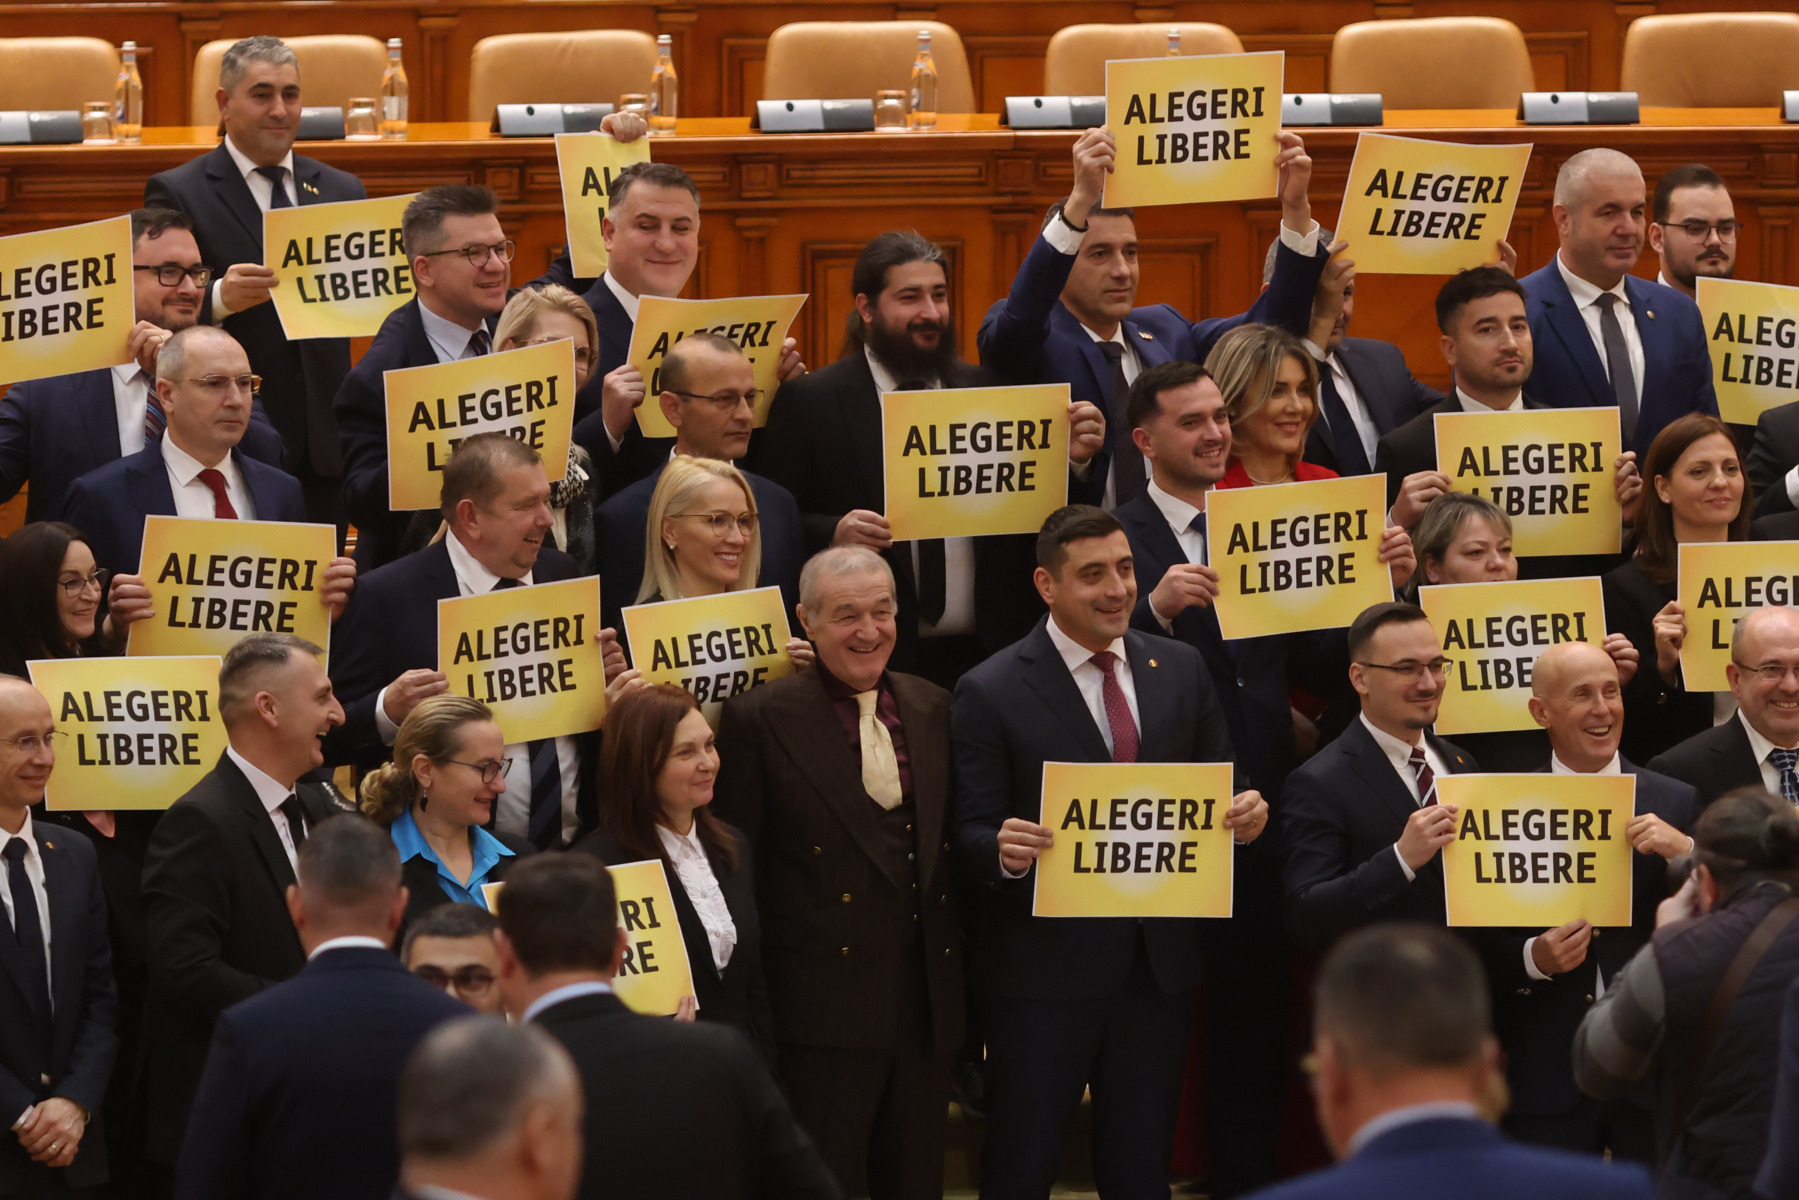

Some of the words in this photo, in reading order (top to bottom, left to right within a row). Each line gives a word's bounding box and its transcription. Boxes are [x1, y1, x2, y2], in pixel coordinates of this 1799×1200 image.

[1123, 86, 1265, 126] ALEGERI
[1136, 128, 1251, 166] LIBERE
[1364, 168, 1509, 204] ALEGERI
[1368, 207, 1487, 241] LIBERE
[281, 227, 407, 269] ALEGER
[0, 252, 117, 301] LEGERI
[296, 264, 412, 304] LIBERE
[1, 296, 105, 342] IBERE
[1712, 312, 1799, 349] ALEG
[1722, 352, 1799, 390] LIBE
[408, 374, 558, 433] ALEGERI
[902, 418, 1053, 457] ALEGERI
[1456, 441, 1604, 478] ALEGERI
[918, 460, 1037, 499] LIBERE
[1472, 483, 1591, 516] IBERE
[1226, 509, 1369, 556] ALEGERI
[157, 552, 318, 592] ALEGERI
[1239, 552, 1356, 595] LIBERE
[1697, 575, 1799, 609] ALEG
[167, 595, 298, 633] LIBERE
[1442, 611, 1588, 651] ALEGERI
[453, 613, 585, 665] ALEGERI
[651, 623, 778, 672] ALEGERI
[467, 658, 577, 705] LIBERE
[1458, 656, 1539, 692] LIBE
[60, 689, 211, 723] ALEGERI
[77, 733, 201, 766] LIBERE
[1061, 798, 1216, 831] ALEGERI
[1458, 808, 1613, 841] ALEGERI
[1073, 841, 1198, 874] LIBERE
[1473, 851, 1597, 884] LIBERE
